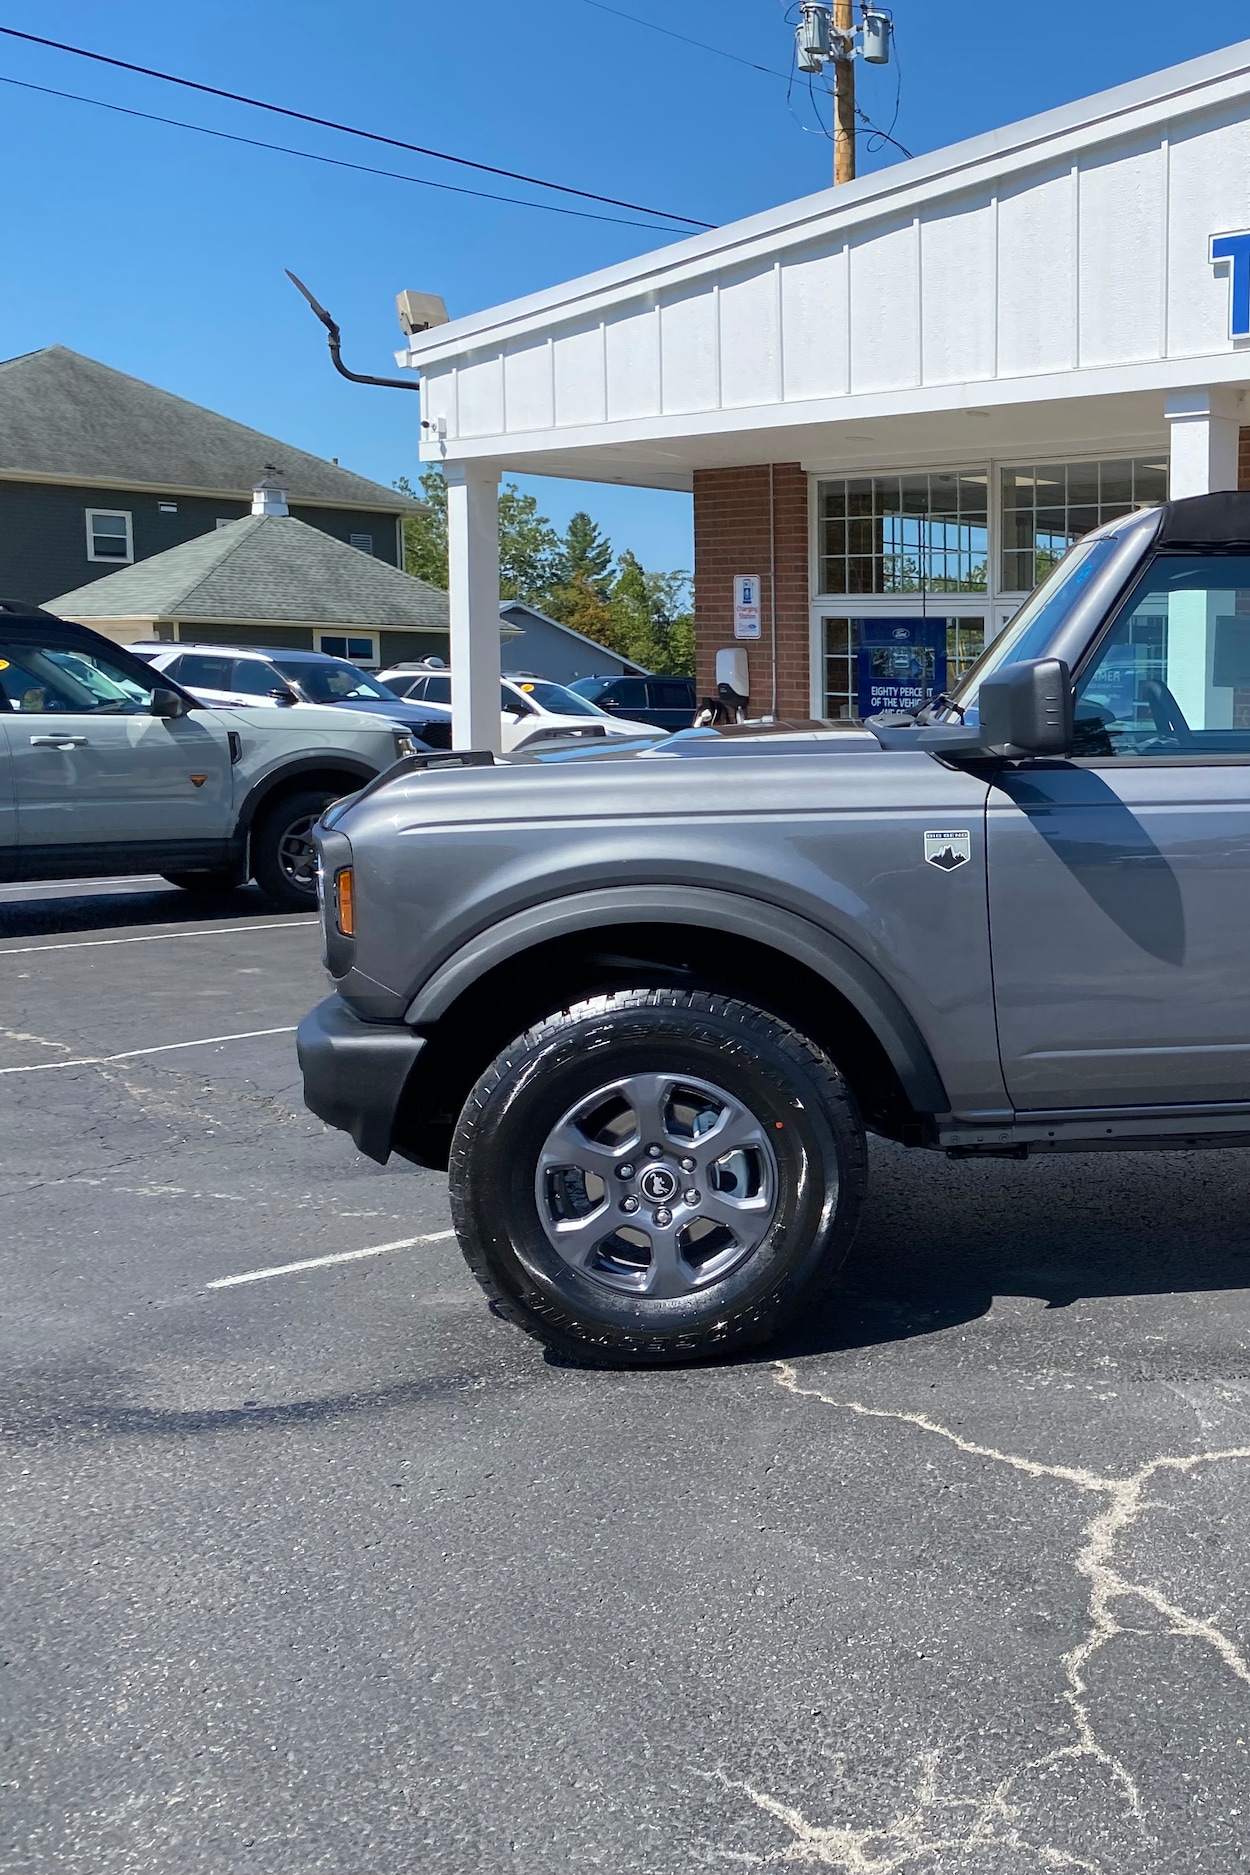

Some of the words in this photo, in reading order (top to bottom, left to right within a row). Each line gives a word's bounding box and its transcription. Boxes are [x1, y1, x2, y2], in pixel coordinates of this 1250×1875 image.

[737, 605, 758, 614] Charging
[871, 686, 899, 696] EIGHTY
[871, 697, 882, 706] OF
[883, 697, 898, 707] THE
[519, 1275, 786, 1352] BRIDGESTONE
